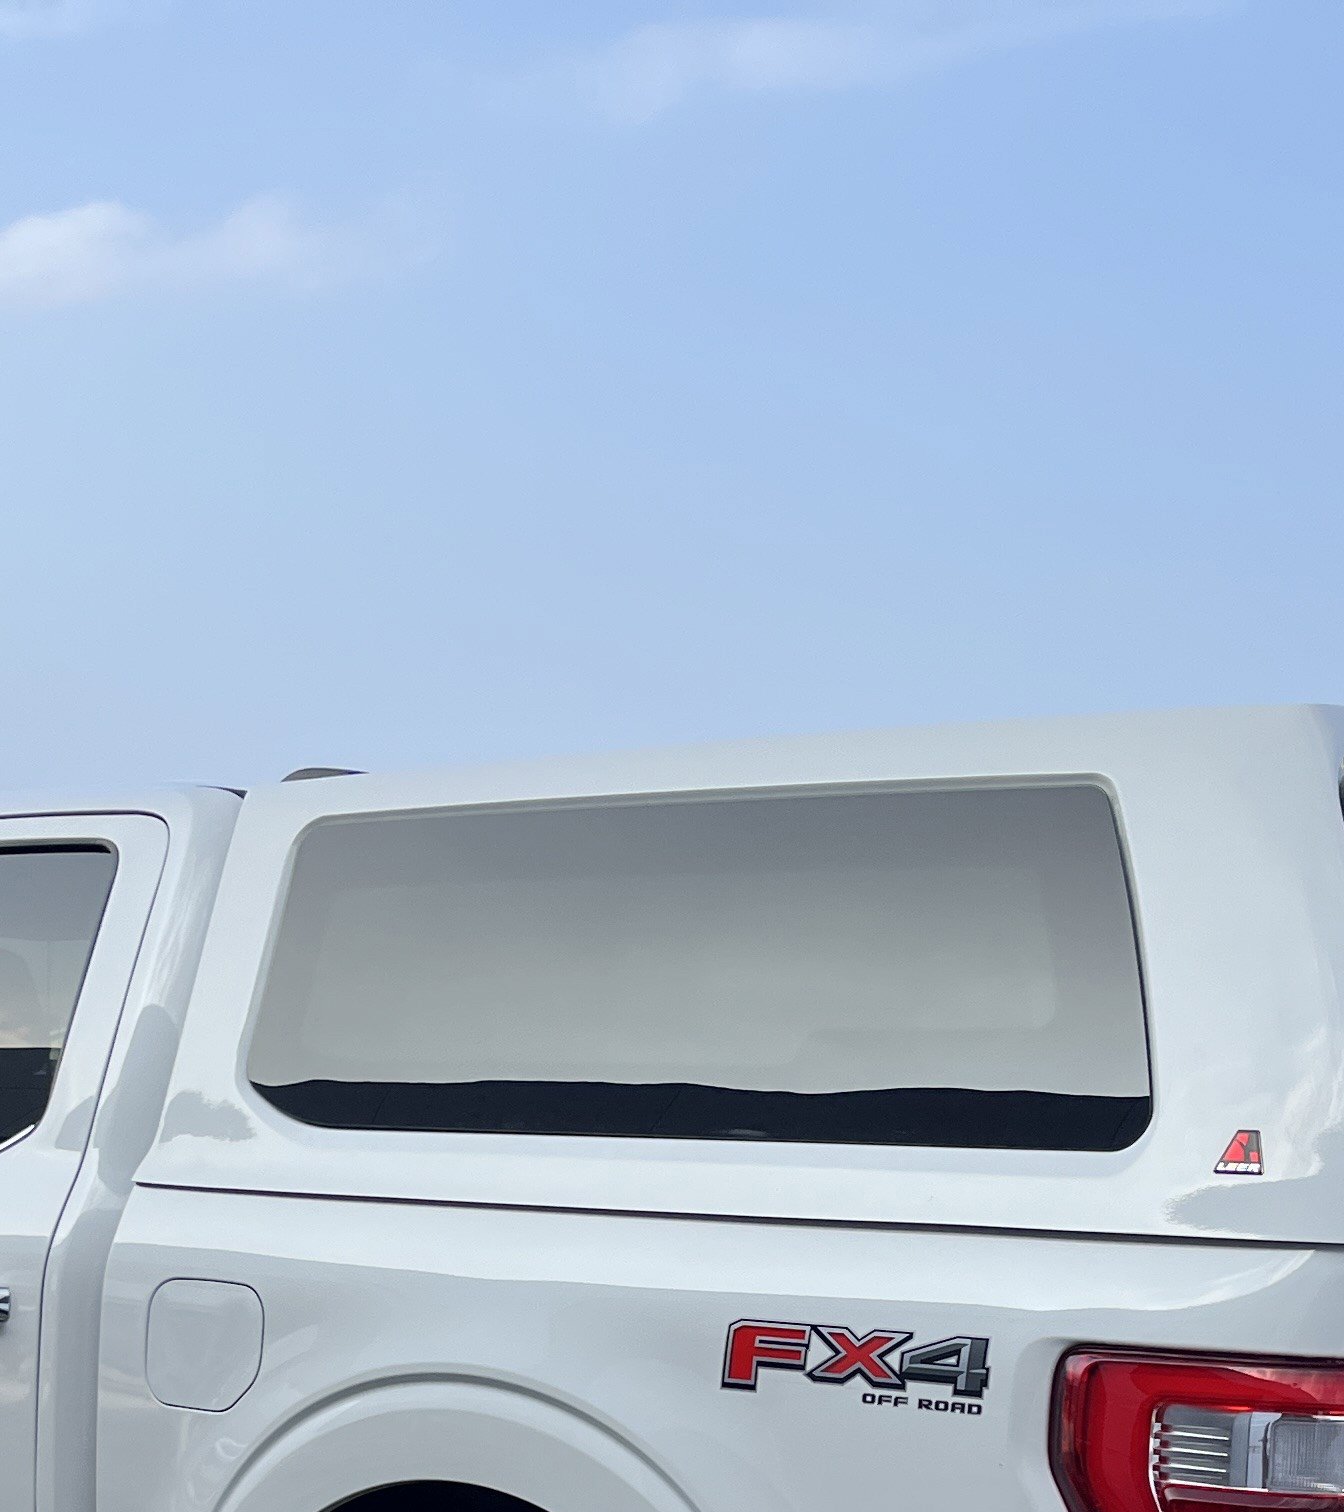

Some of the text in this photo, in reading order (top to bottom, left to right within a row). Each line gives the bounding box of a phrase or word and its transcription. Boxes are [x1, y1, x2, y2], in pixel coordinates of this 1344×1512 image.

[1216, 1161, 1261, 1173] LEER
[720, 1318, 991, 1400] FX4
[861, 1392, 983, 1416] OFF ROAD
